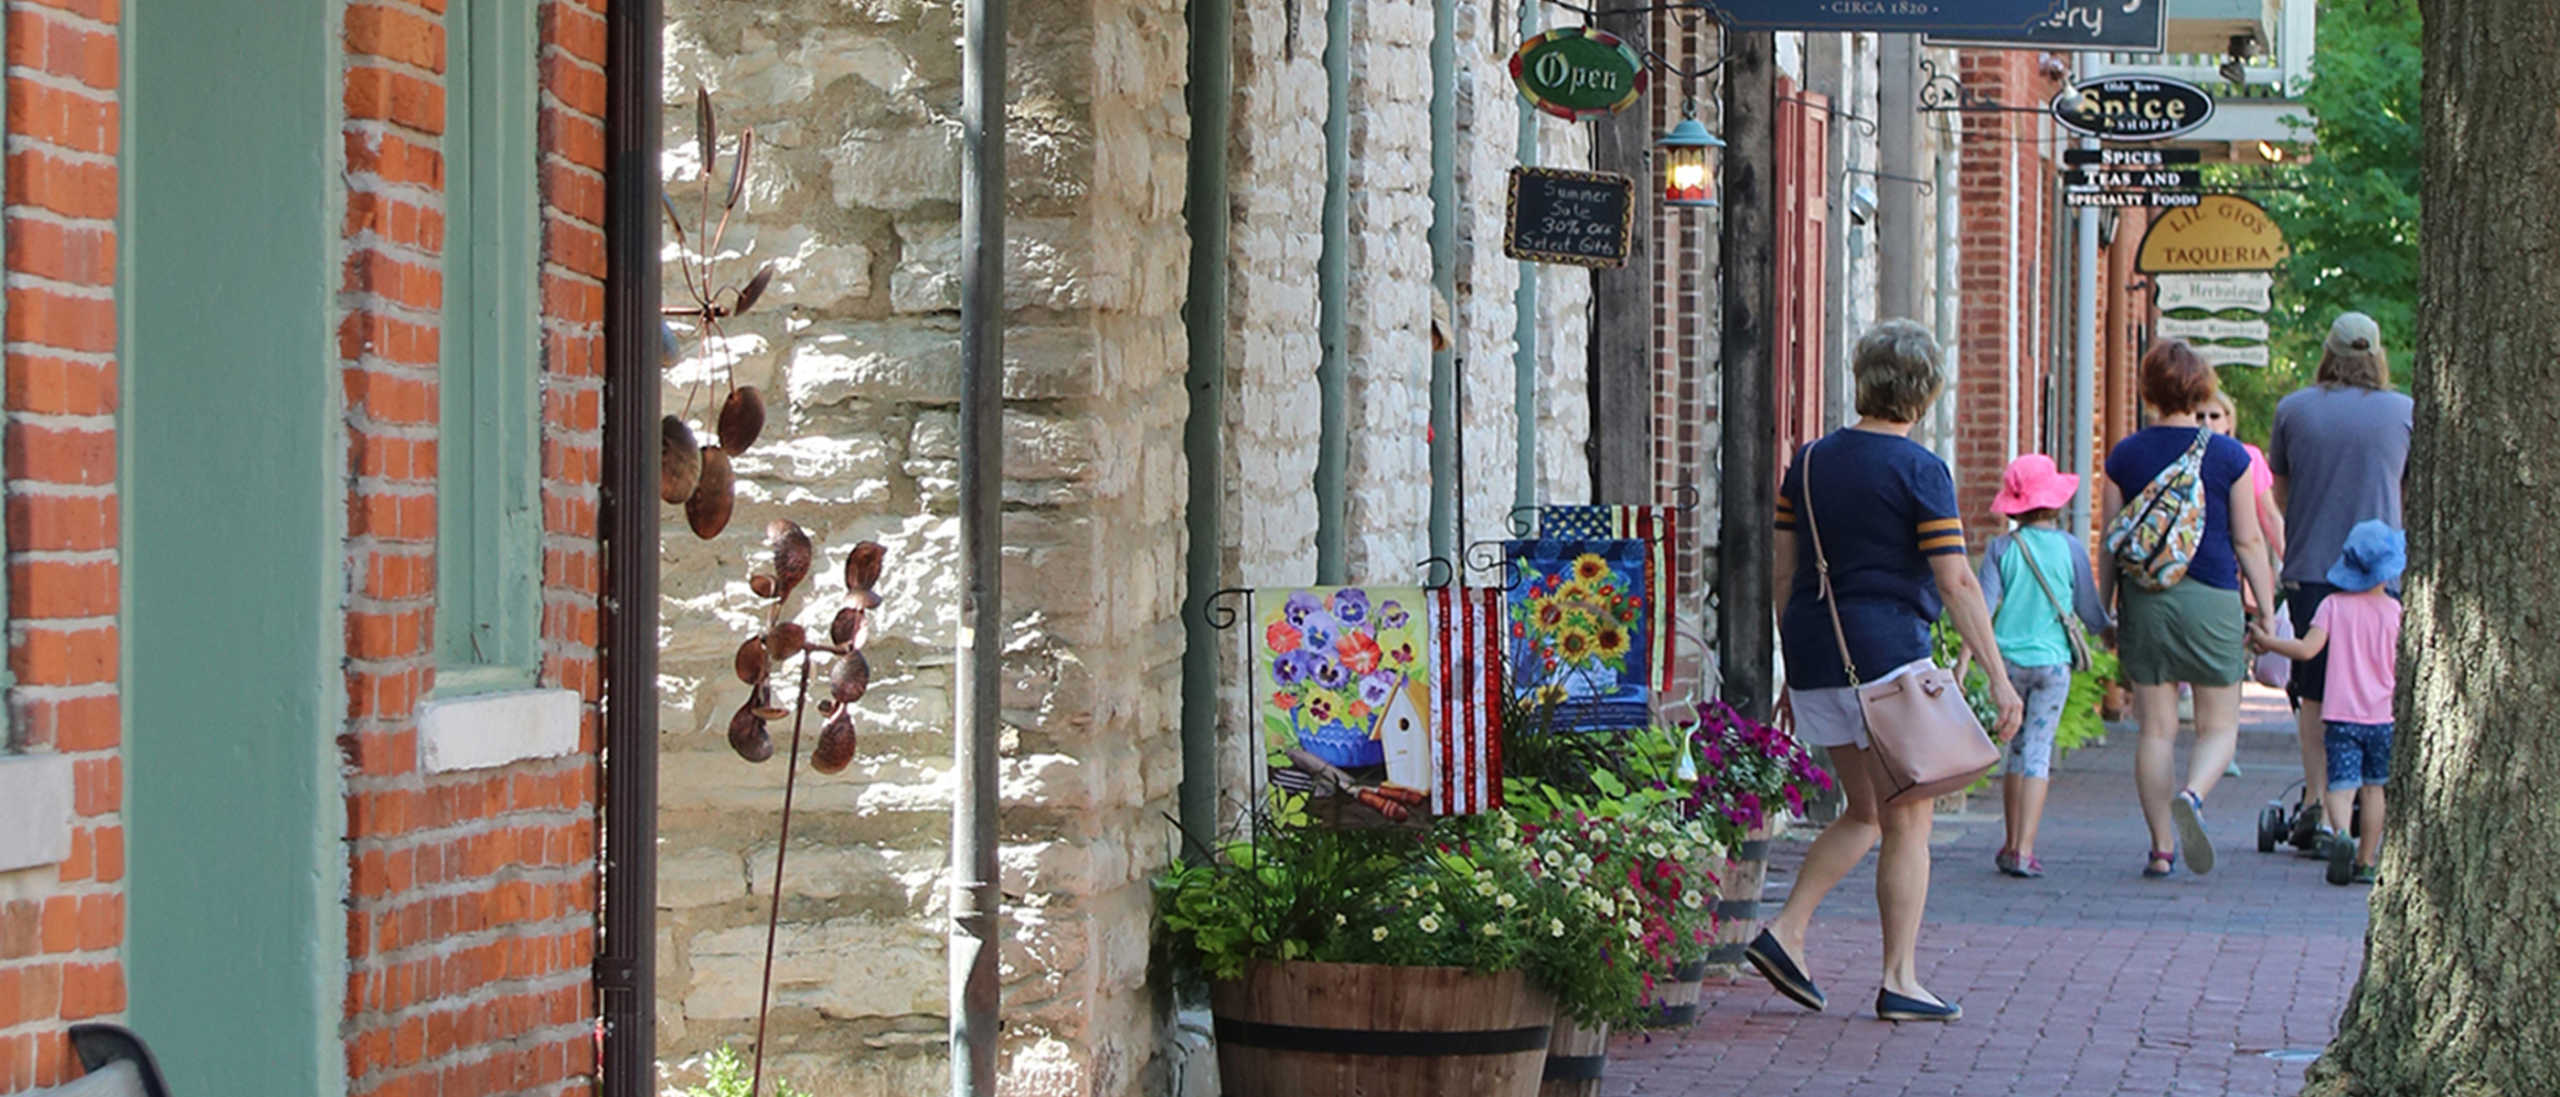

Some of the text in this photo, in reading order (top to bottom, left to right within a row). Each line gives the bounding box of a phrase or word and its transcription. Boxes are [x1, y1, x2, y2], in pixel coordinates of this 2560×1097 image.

[1832, 1, 1927, 15] CIRCA 1820
[1535, 51, 1617, 96] Open
[2077, 88, 2185, 127] Spice
[2117, 119, 2180, 131] SHOPPE
[2142, 172, 2181, 186] AND
[1544, 180, 1611, 202] Summer
[1550, 200, 1591, 219] Sale
[1541, 217, 1580, 235] 30%
[1521, 231, 1614, 255] Select Gifts
[2164, 247, 2271, 265] TAQUERIA
